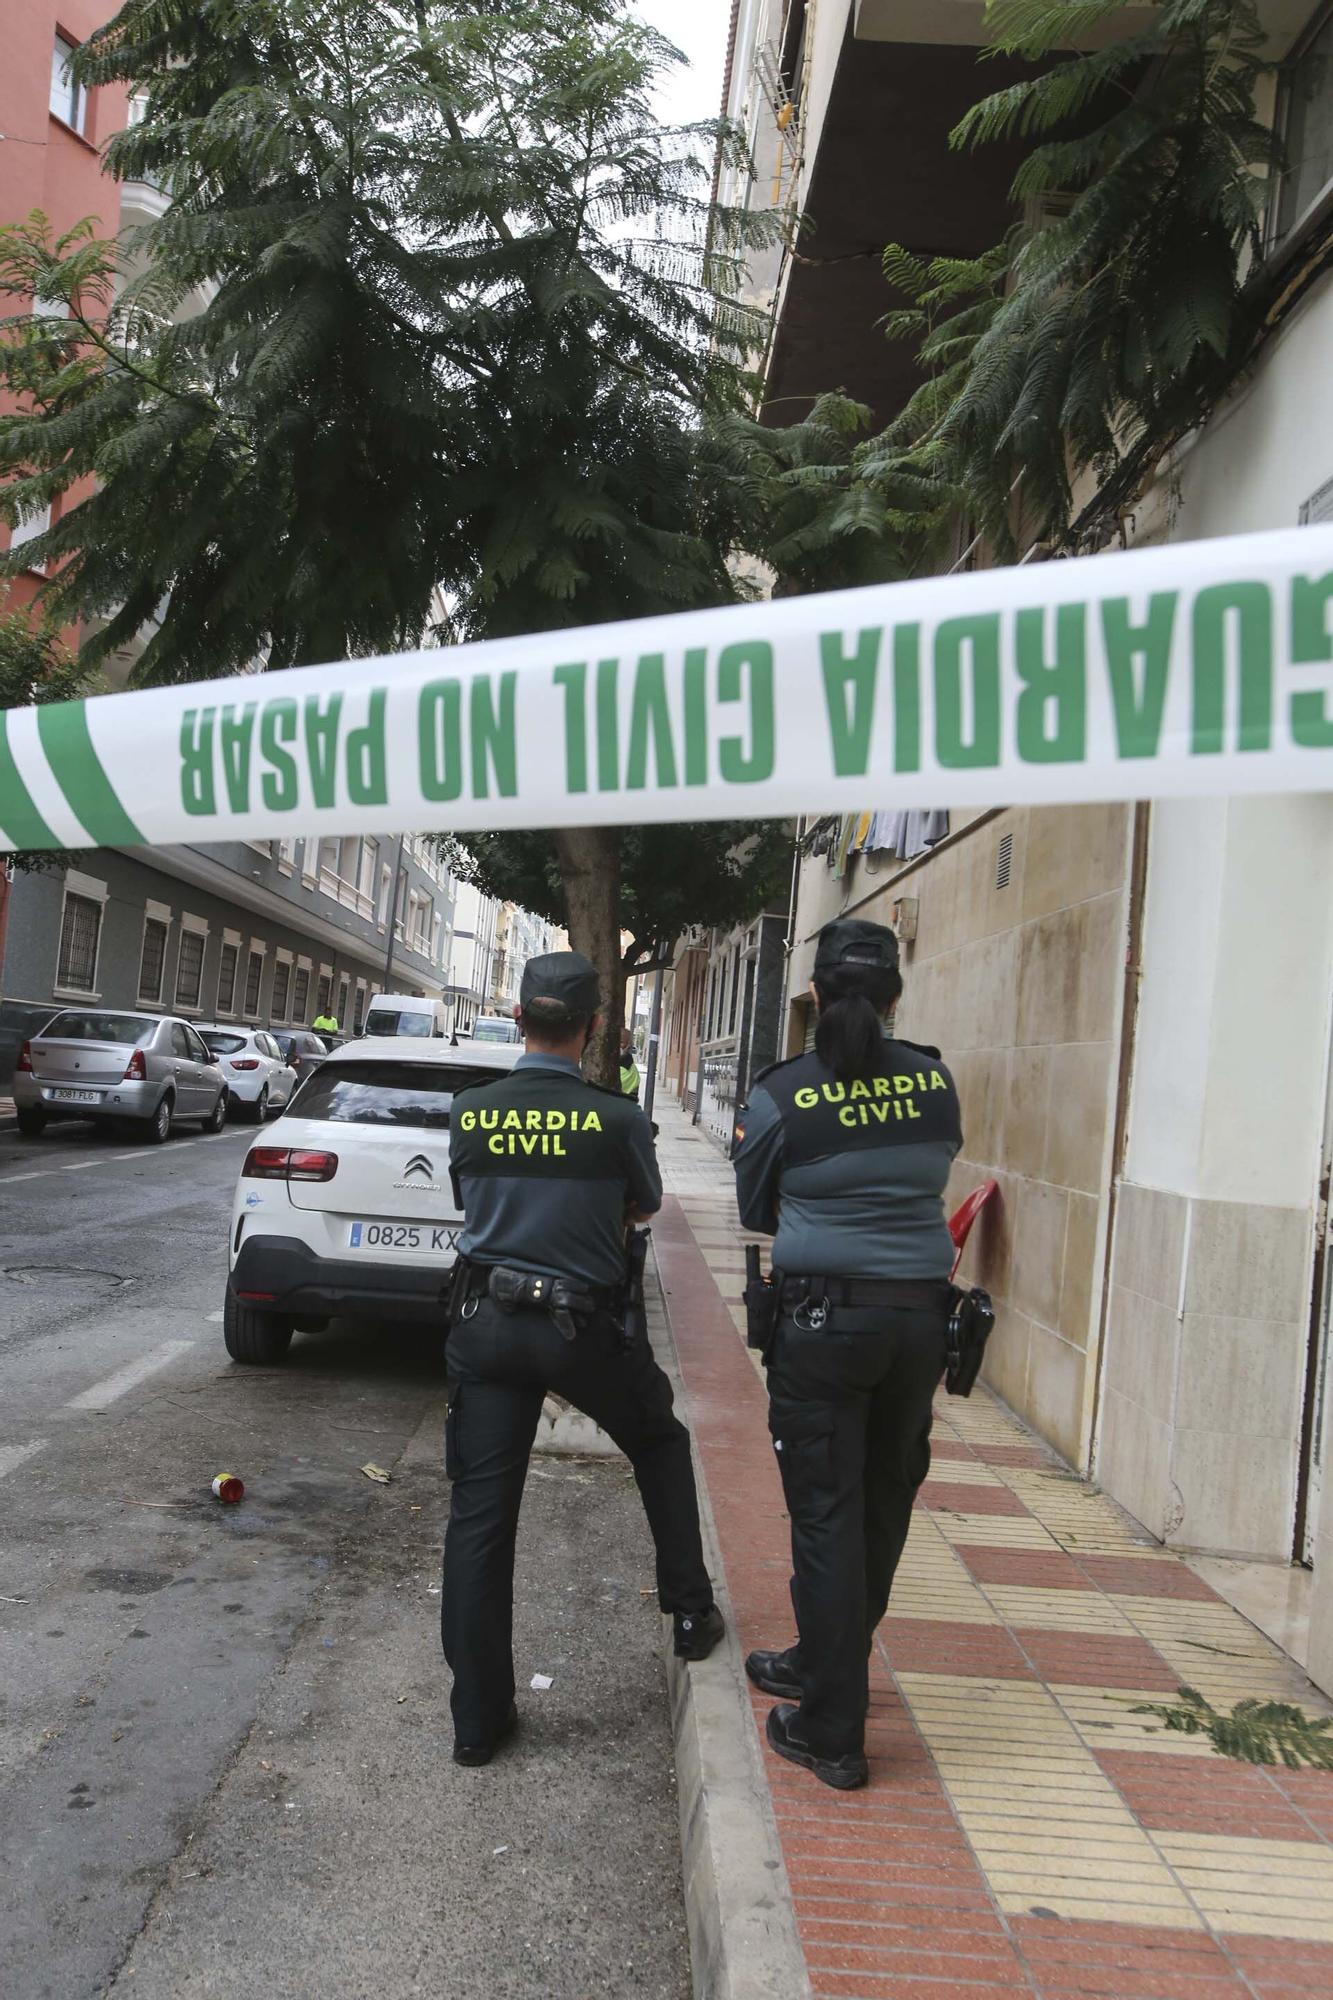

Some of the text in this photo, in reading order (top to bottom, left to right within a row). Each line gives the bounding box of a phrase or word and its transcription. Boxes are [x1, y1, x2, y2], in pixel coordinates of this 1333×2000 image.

[552, 640, 775, 794] CIVIL
[179, 686, 389, 816] PASAR
[417, 671, 518, 801] NO
[794, 1070, 948, 1109] GUARDIA
[460, 1109, 602, 1132] GUARDIA
[838, 1098, 921, 1127] CIVIL
[488, 1133, 567, 1156] CIVIL
[367, 1225, 465, 1251] 0825 KX
